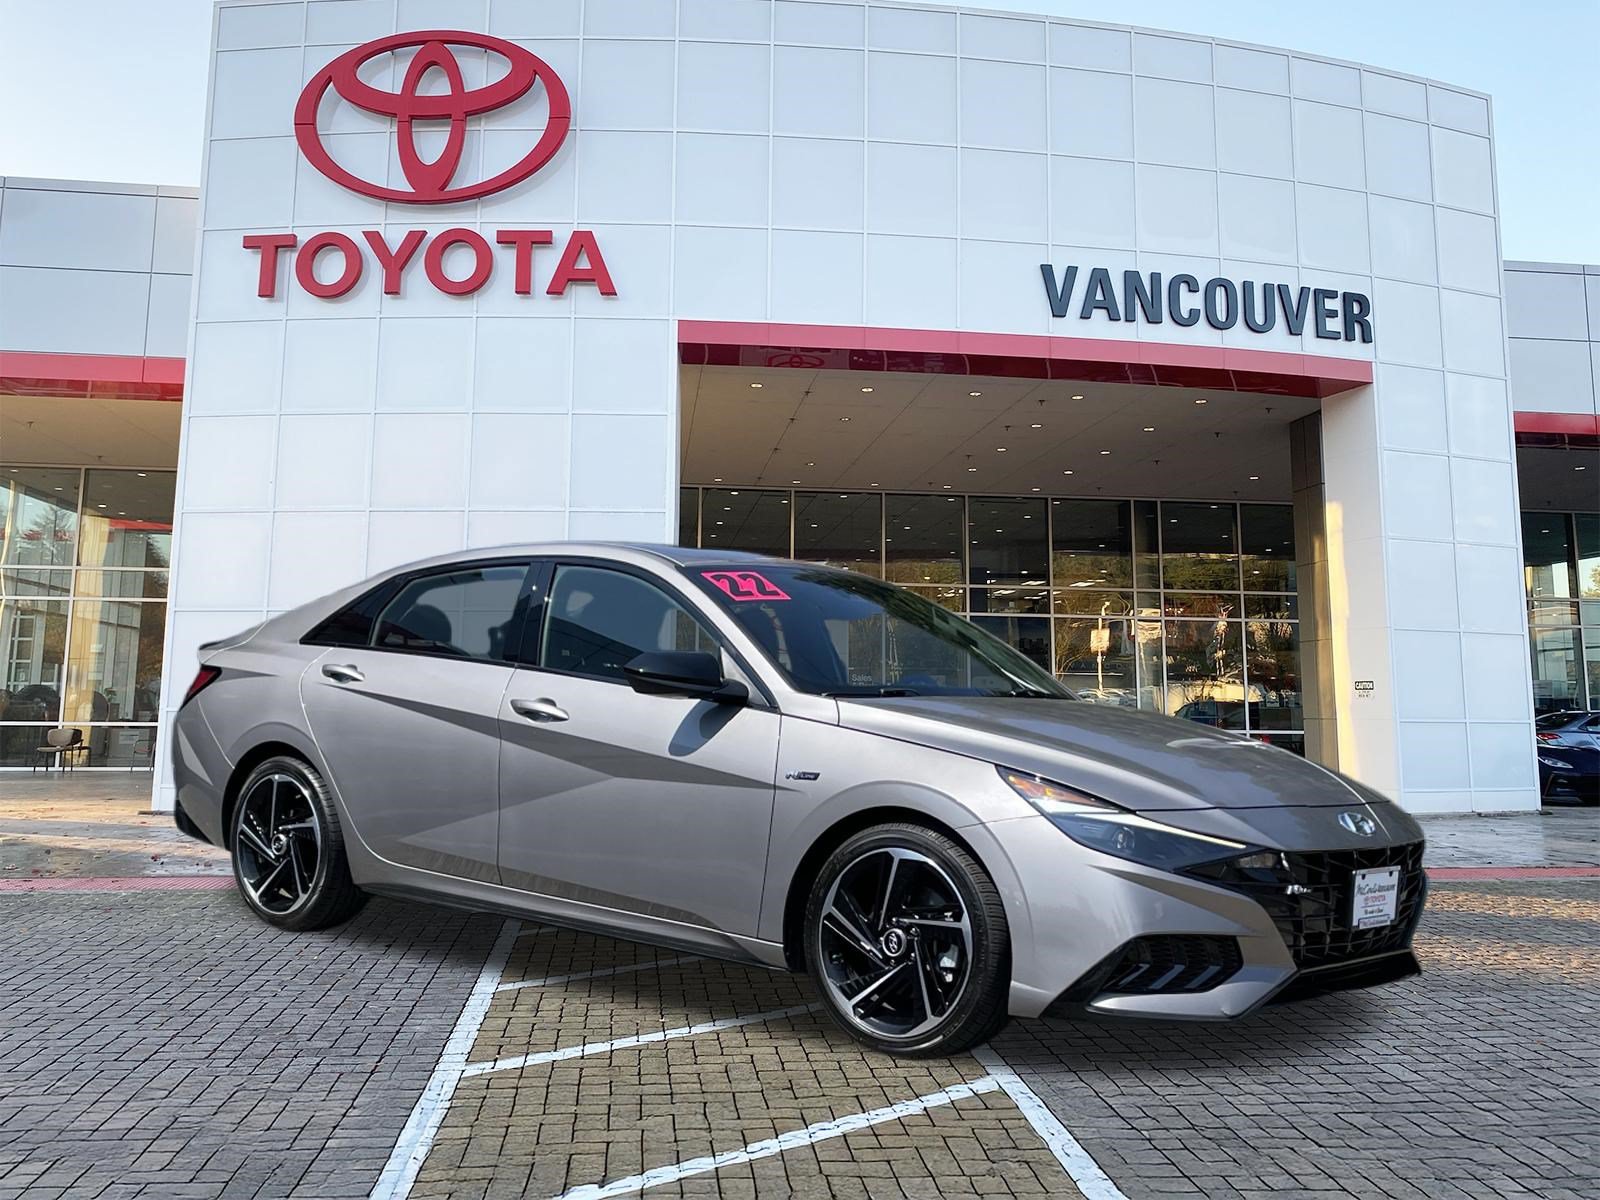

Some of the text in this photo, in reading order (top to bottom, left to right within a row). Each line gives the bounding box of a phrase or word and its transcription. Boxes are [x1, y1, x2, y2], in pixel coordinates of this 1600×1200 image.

[243, 228, 618, 298] TOYOTA
[1040, 263, 1373, 343] VANCOUVER
[710, 573, 781, 597] 22
[851, 673, 873, 682] Sales
